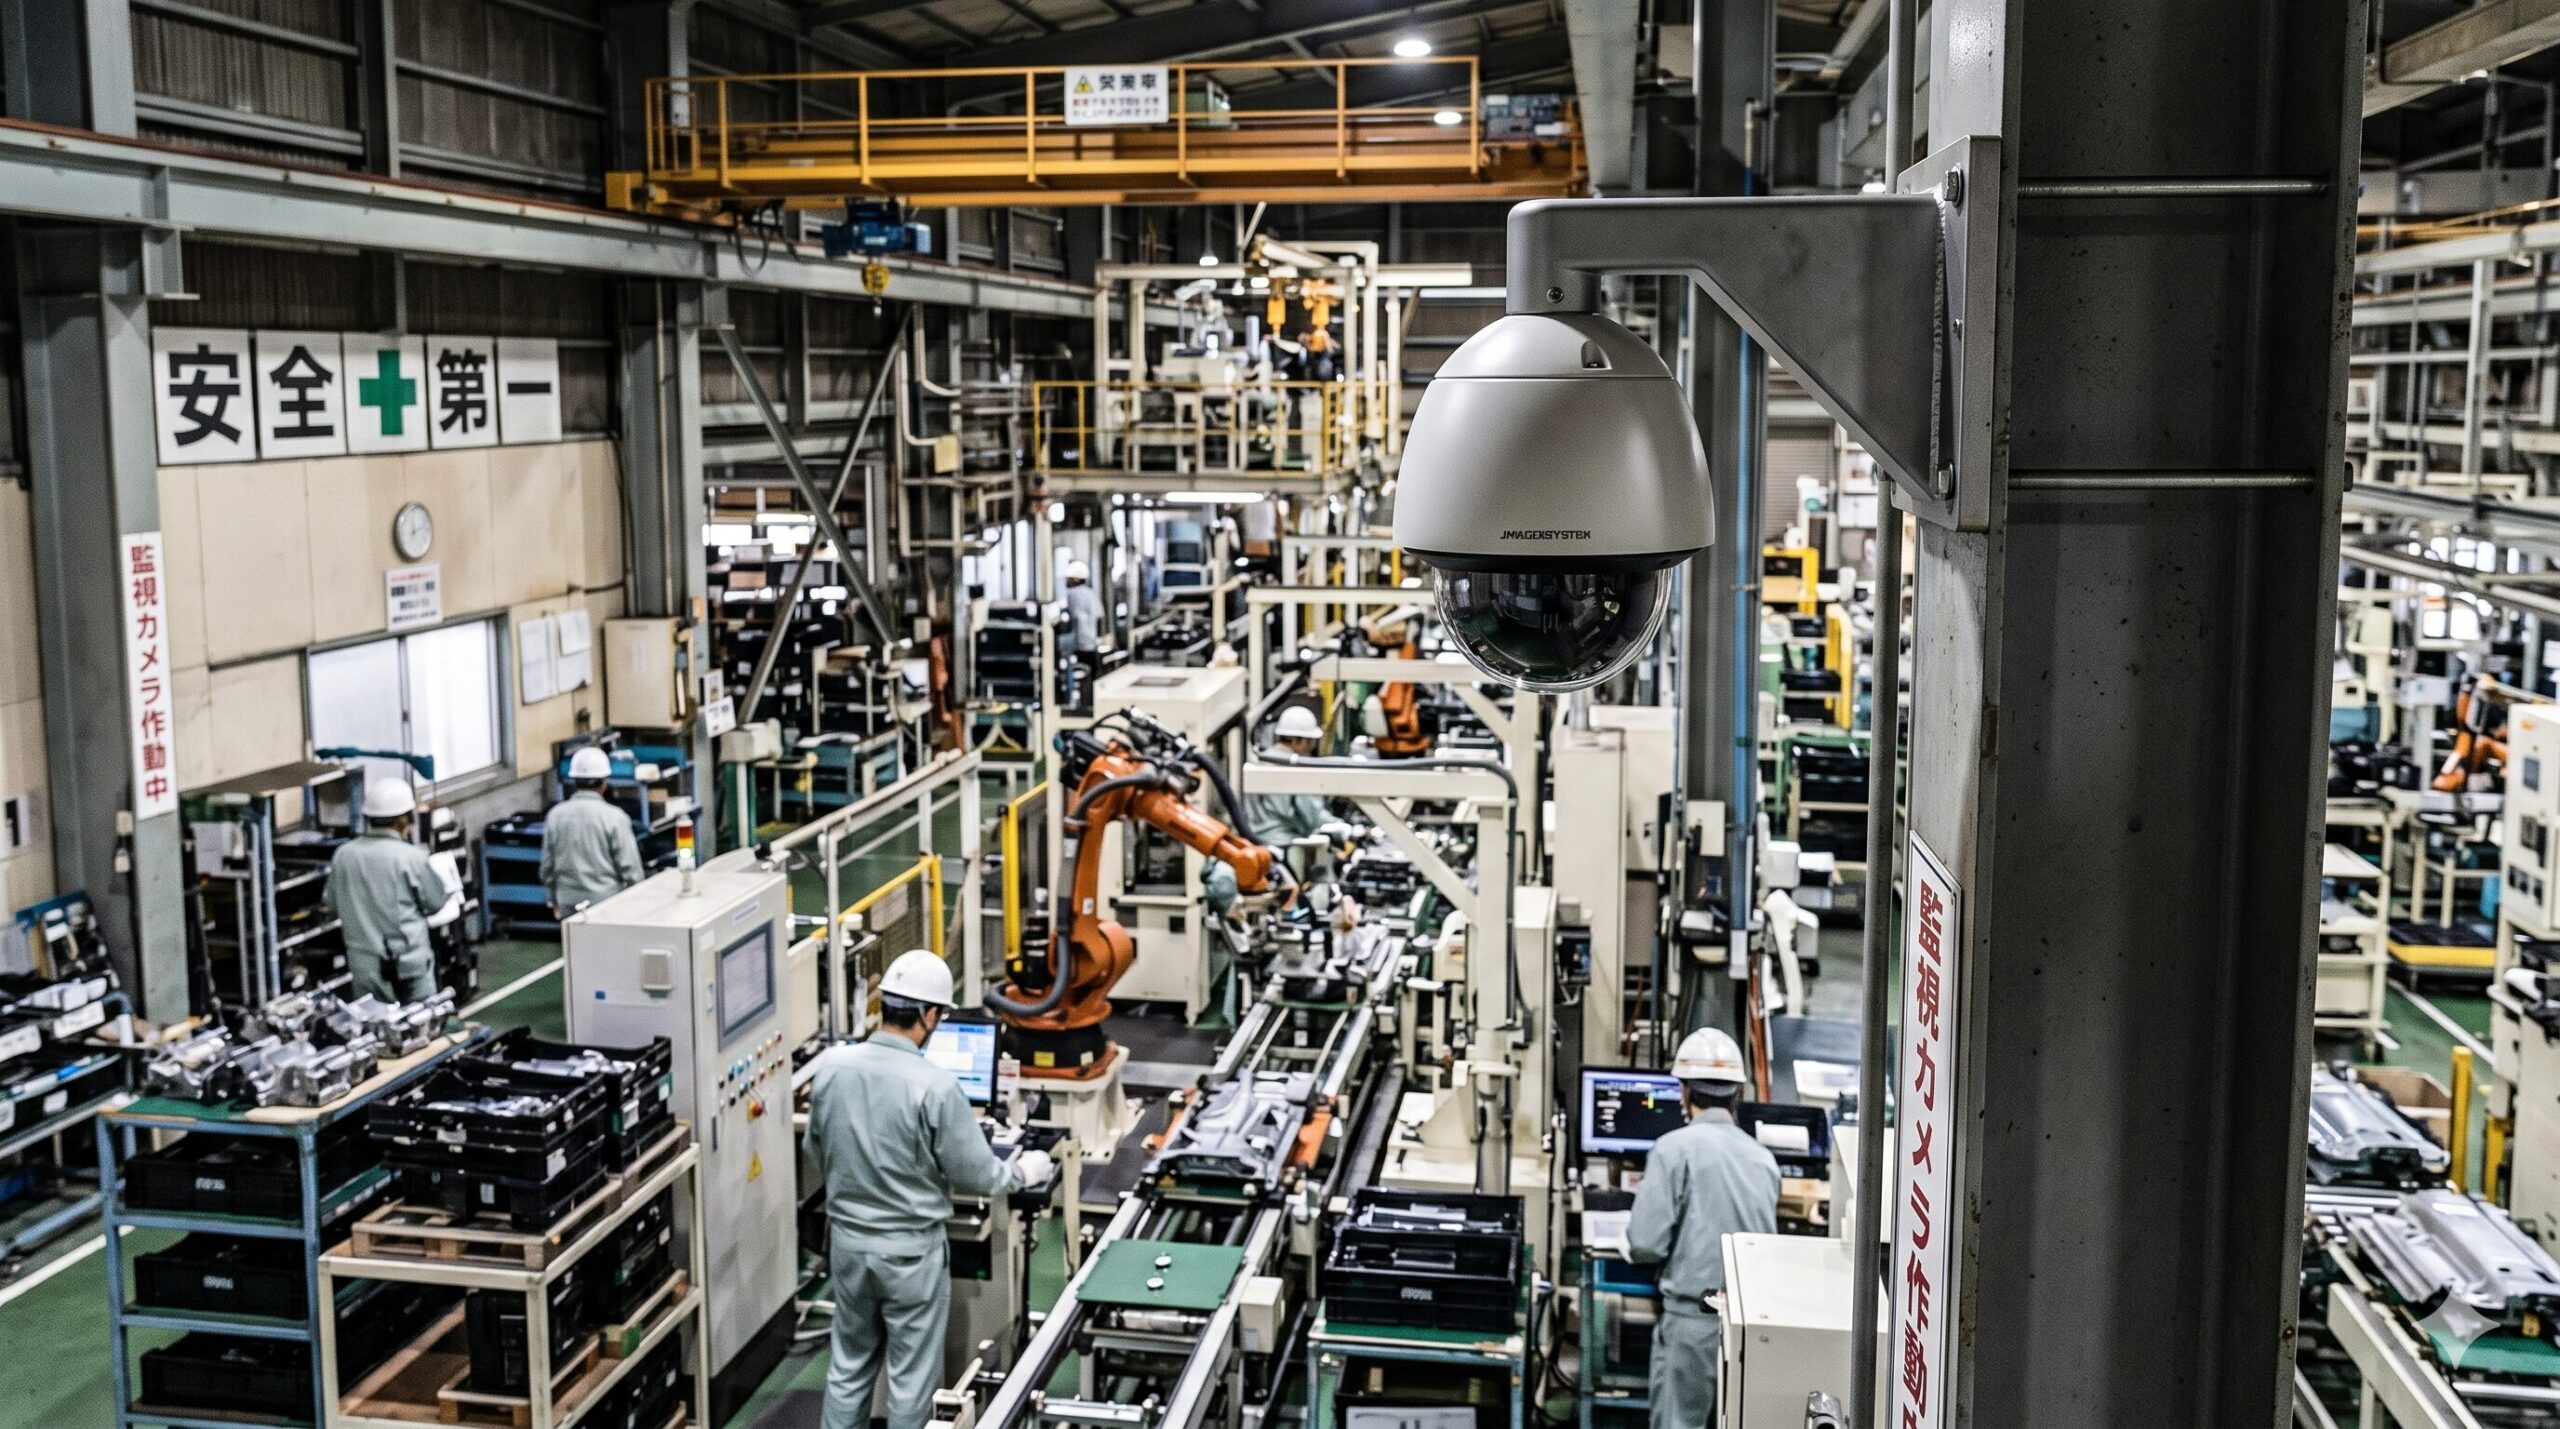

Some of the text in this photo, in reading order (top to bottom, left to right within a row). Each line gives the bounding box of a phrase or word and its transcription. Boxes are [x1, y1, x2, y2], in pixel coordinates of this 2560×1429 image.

[131, 544, 168, 801] 監視カメラ作動中
[1902, 878, 1943, 1429] 監視カメラ作動
